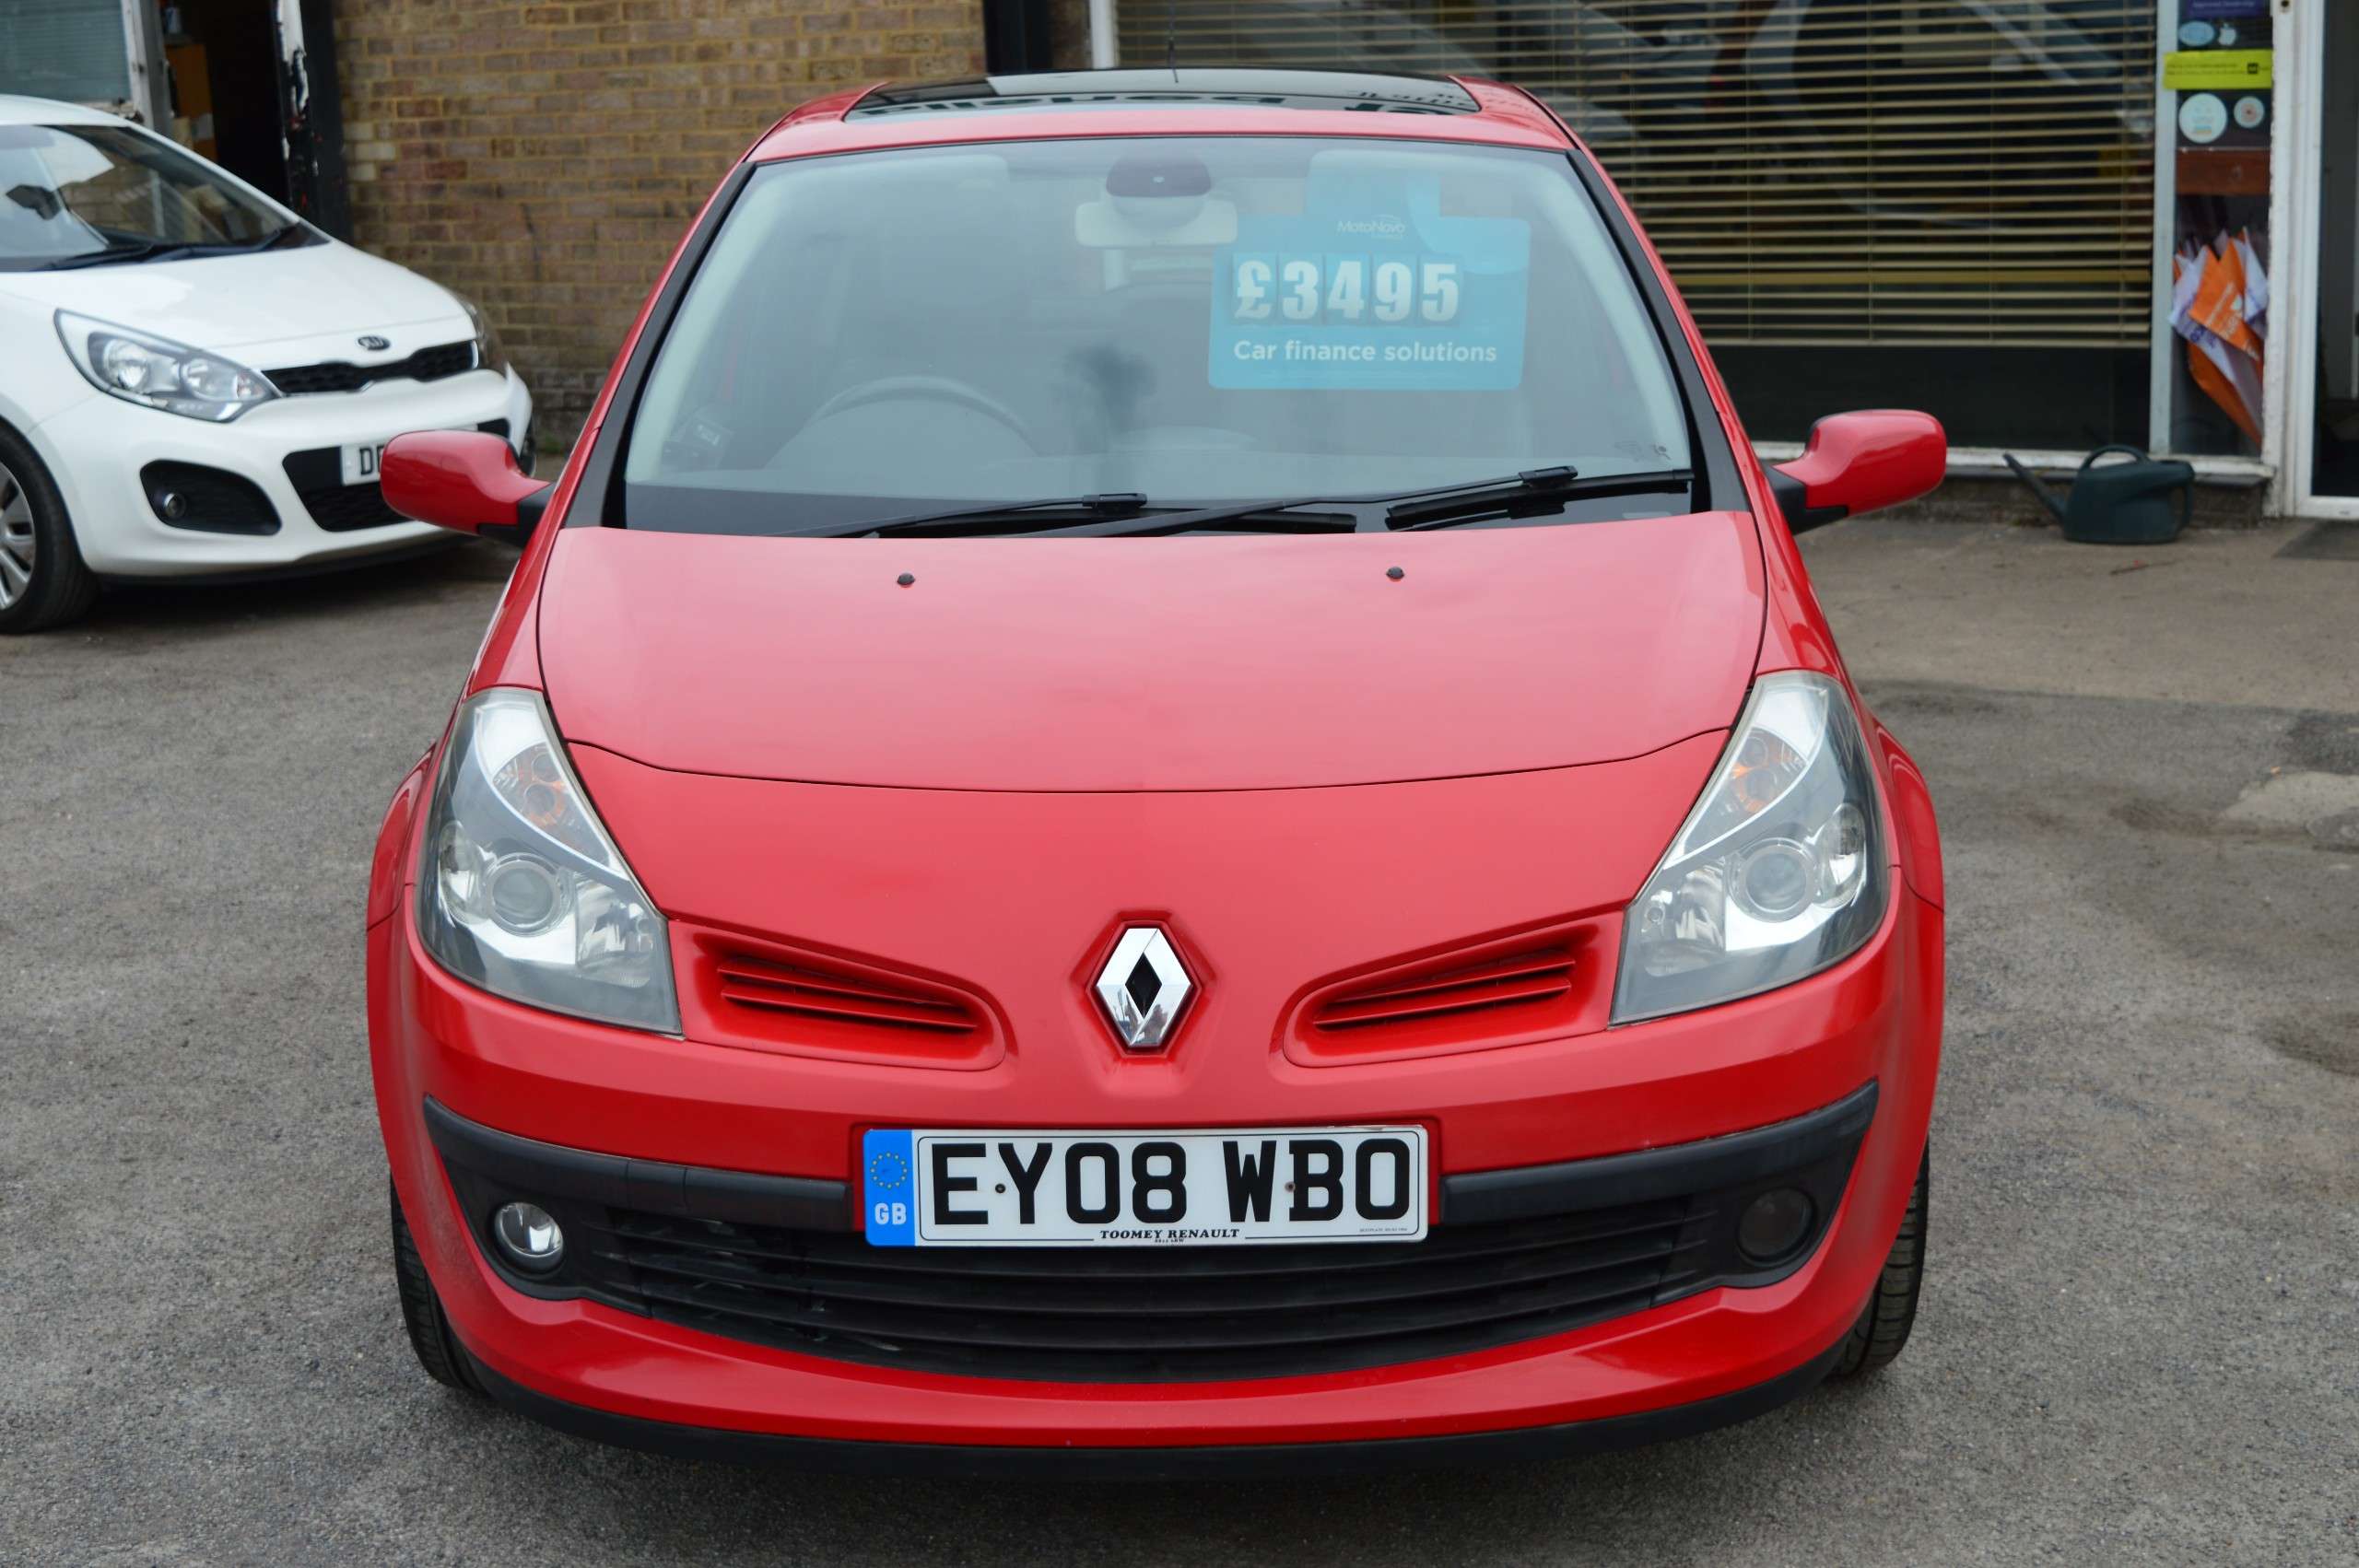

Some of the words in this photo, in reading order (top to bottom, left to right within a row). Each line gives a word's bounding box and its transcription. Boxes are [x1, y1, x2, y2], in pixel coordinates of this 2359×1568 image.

[1234, 261, 1460, 322] £3495
[1234, 340, 1277, 360] Car
[1285, 339, 1376, 361] finance
[1384, 341, 1497, 362] solutions
[932, 1141, 1187, 1225] EY08
[1222, 1138, 1411, 1223] WBO
[874, 1202, 907, 1225] GB
[1100, 1229, 1163, 1239] TOOMEY
[1168, 1228, 1240, 1239] RENAULT
